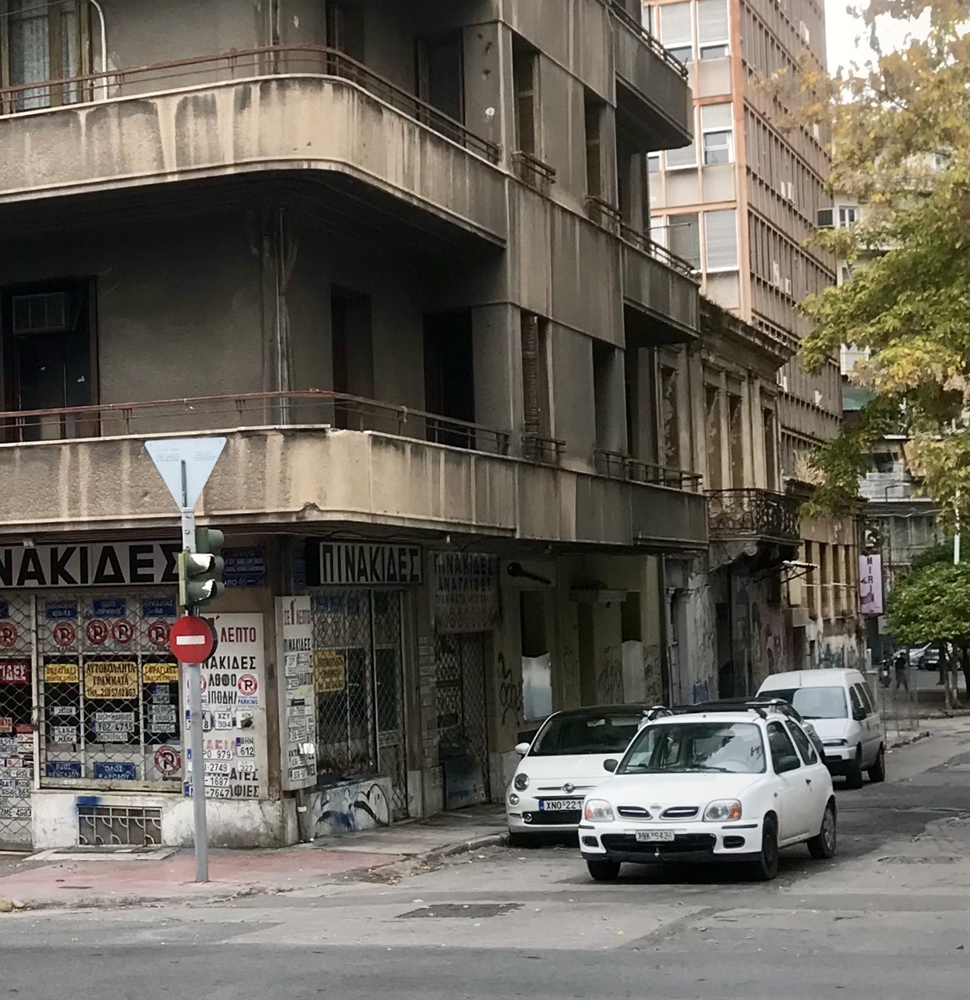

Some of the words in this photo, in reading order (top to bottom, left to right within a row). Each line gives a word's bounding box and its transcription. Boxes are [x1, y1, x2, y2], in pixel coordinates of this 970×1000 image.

[322, 544, 419, 583] ΠΙΝΑΚΙΔΕΣ
[220, 627, 257, 643] ΛΕΠΤΟ
[201, 656, 256, 669] ΝΑΚΙΔΕΣ
[208, 691, 237, 705] ΠΟΔΗ
[217, 750, 231, 759] 979
[240, 747, 254, 755] 612
